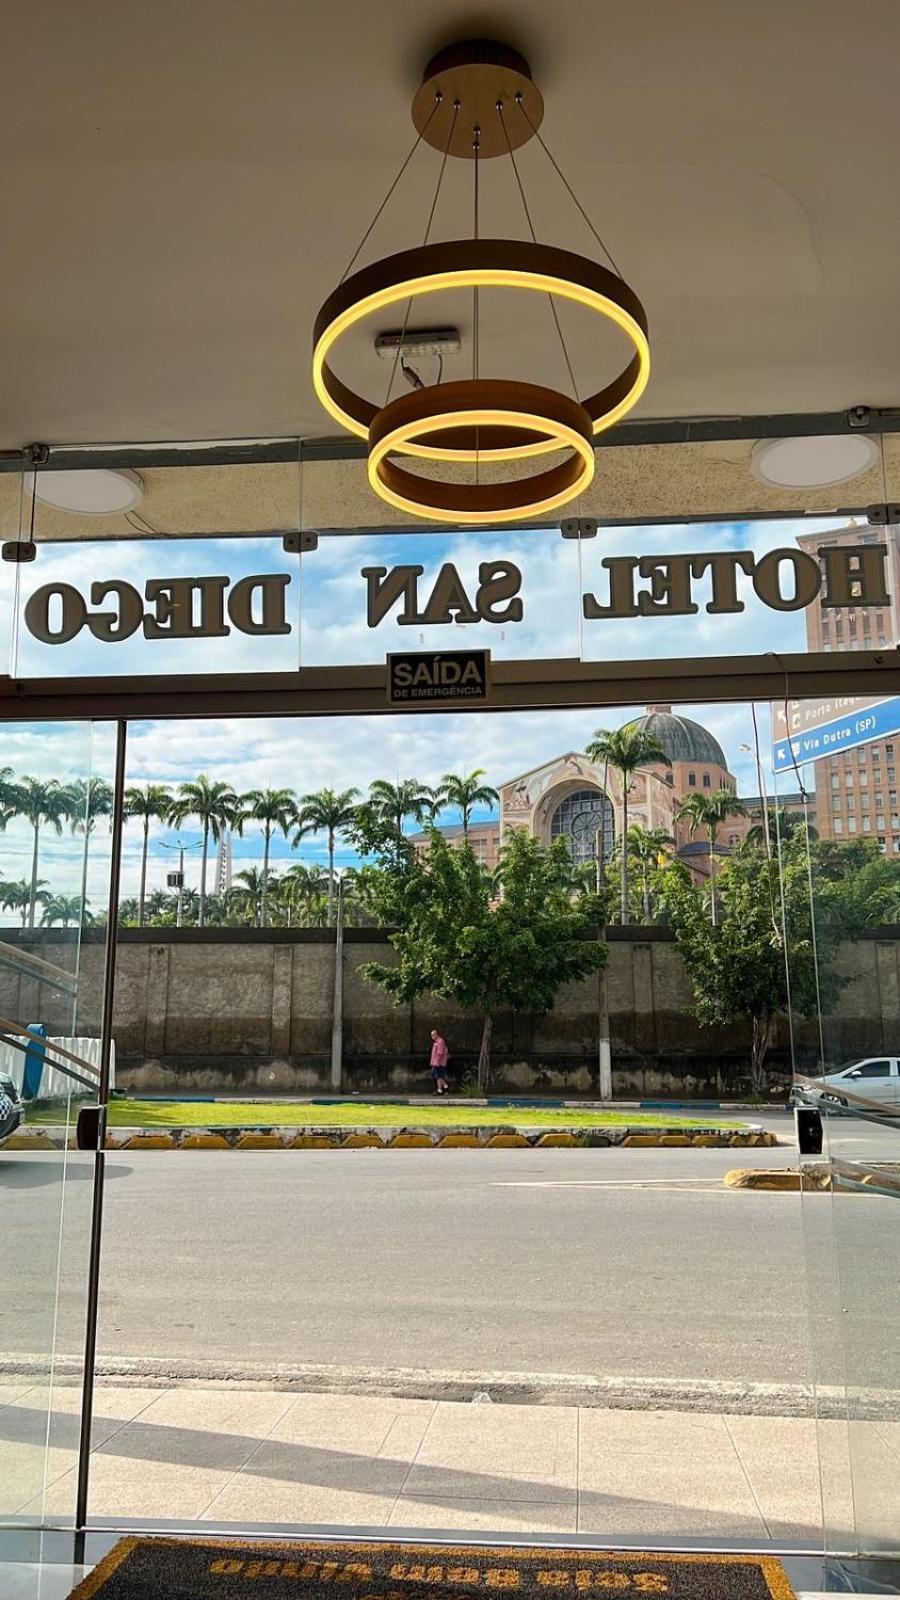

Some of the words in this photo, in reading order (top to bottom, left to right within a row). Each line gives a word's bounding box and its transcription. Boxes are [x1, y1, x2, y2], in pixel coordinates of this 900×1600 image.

[393, 656, 482, 686] SAÍDA
[394, 688, 409, 698] DE
[411, 686, 482, 697] EMERGÊNCIA
[803, 740, 819, 751] Via
[823, 728, 851, 744] Dutra
[856, 716, 876, 733] (SP)
